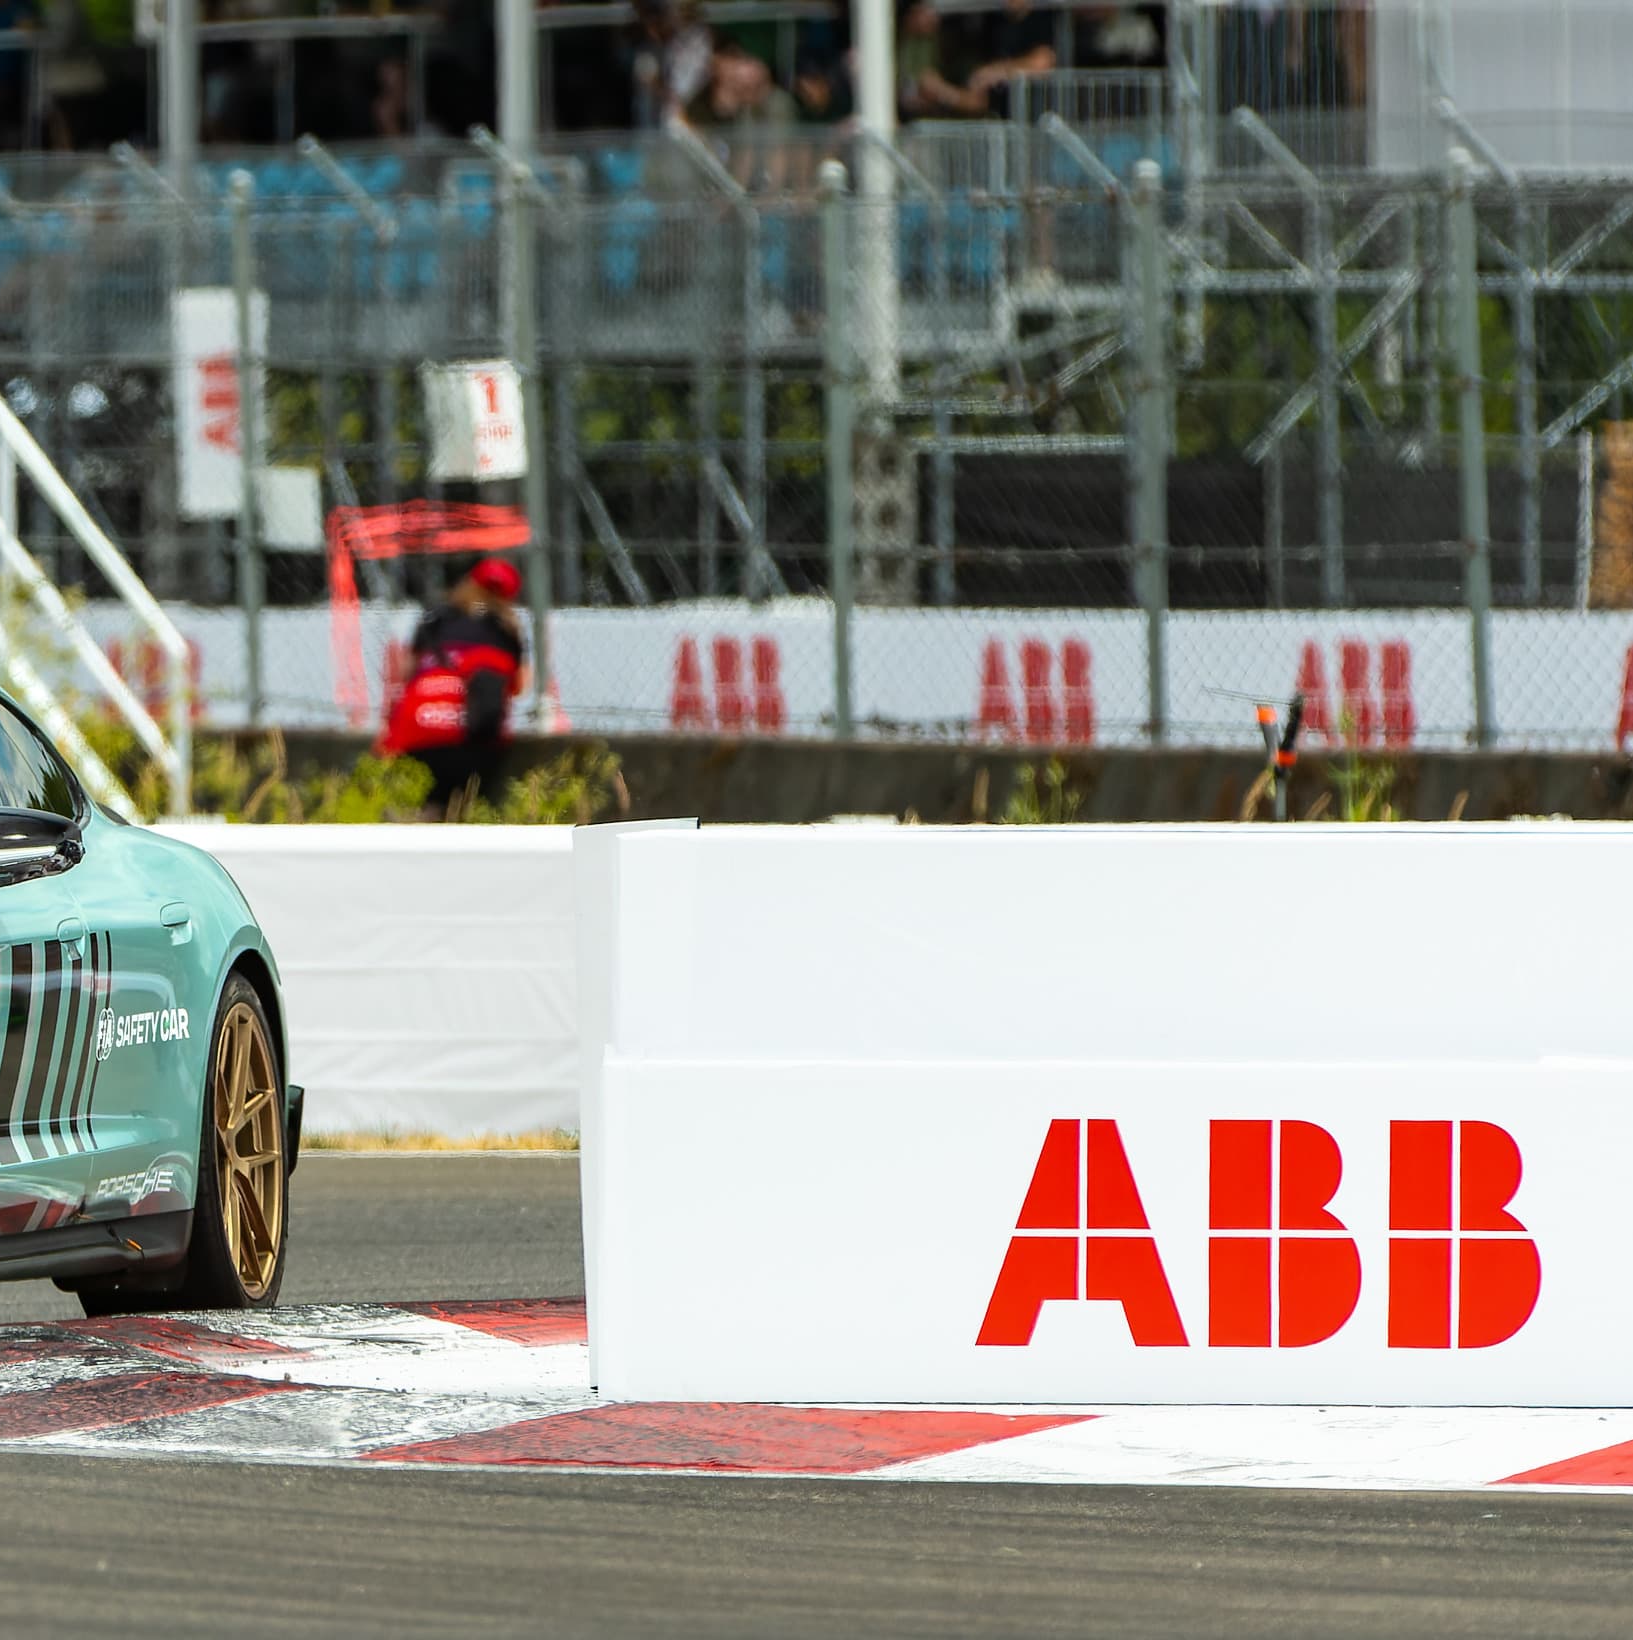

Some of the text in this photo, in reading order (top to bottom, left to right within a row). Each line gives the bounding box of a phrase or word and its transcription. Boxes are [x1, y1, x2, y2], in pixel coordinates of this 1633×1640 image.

[669, 635, 785, 733] ABB
[978, 637, 1096, 745] ABB
[1295, 637, 1417, 750] ABB
[115, 1010, 160, 1048] SAFETY
[160, 1008, 190, 1042] CAR
[975, 1118, 1542, 1350] ABB
